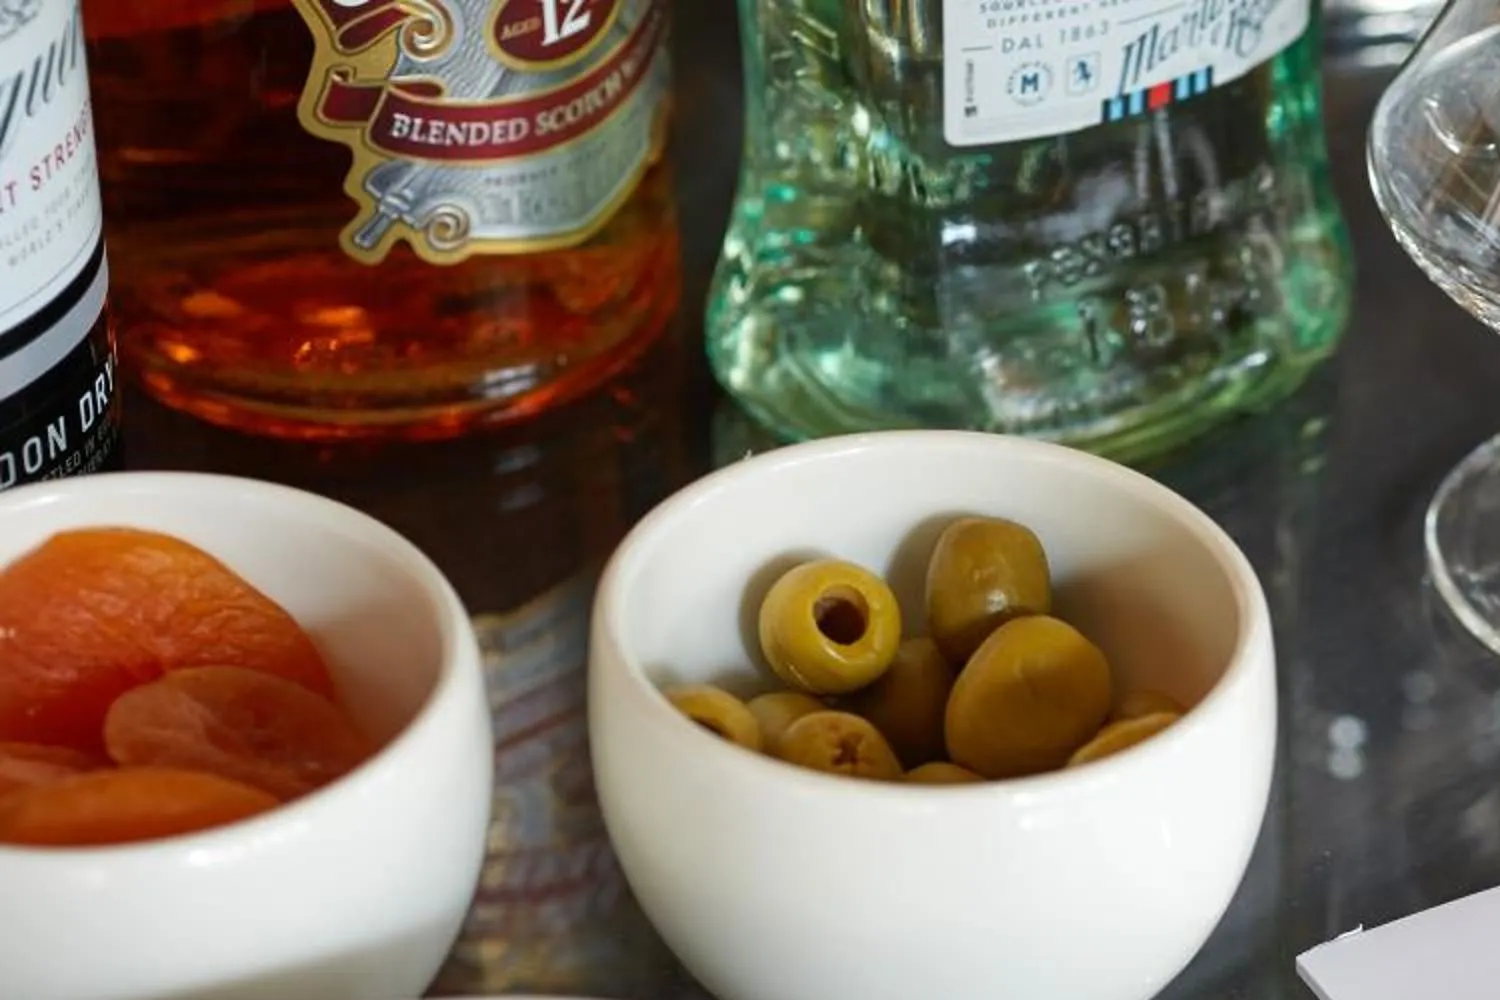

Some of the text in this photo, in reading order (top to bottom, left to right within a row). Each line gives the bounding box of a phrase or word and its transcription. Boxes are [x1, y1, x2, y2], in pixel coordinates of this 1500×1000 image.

[1001, 34, 1043, 54] DAL
[390, 72, 624, 147] BLENDED SCOTCH
[79, 352, 114, 433] DRY
